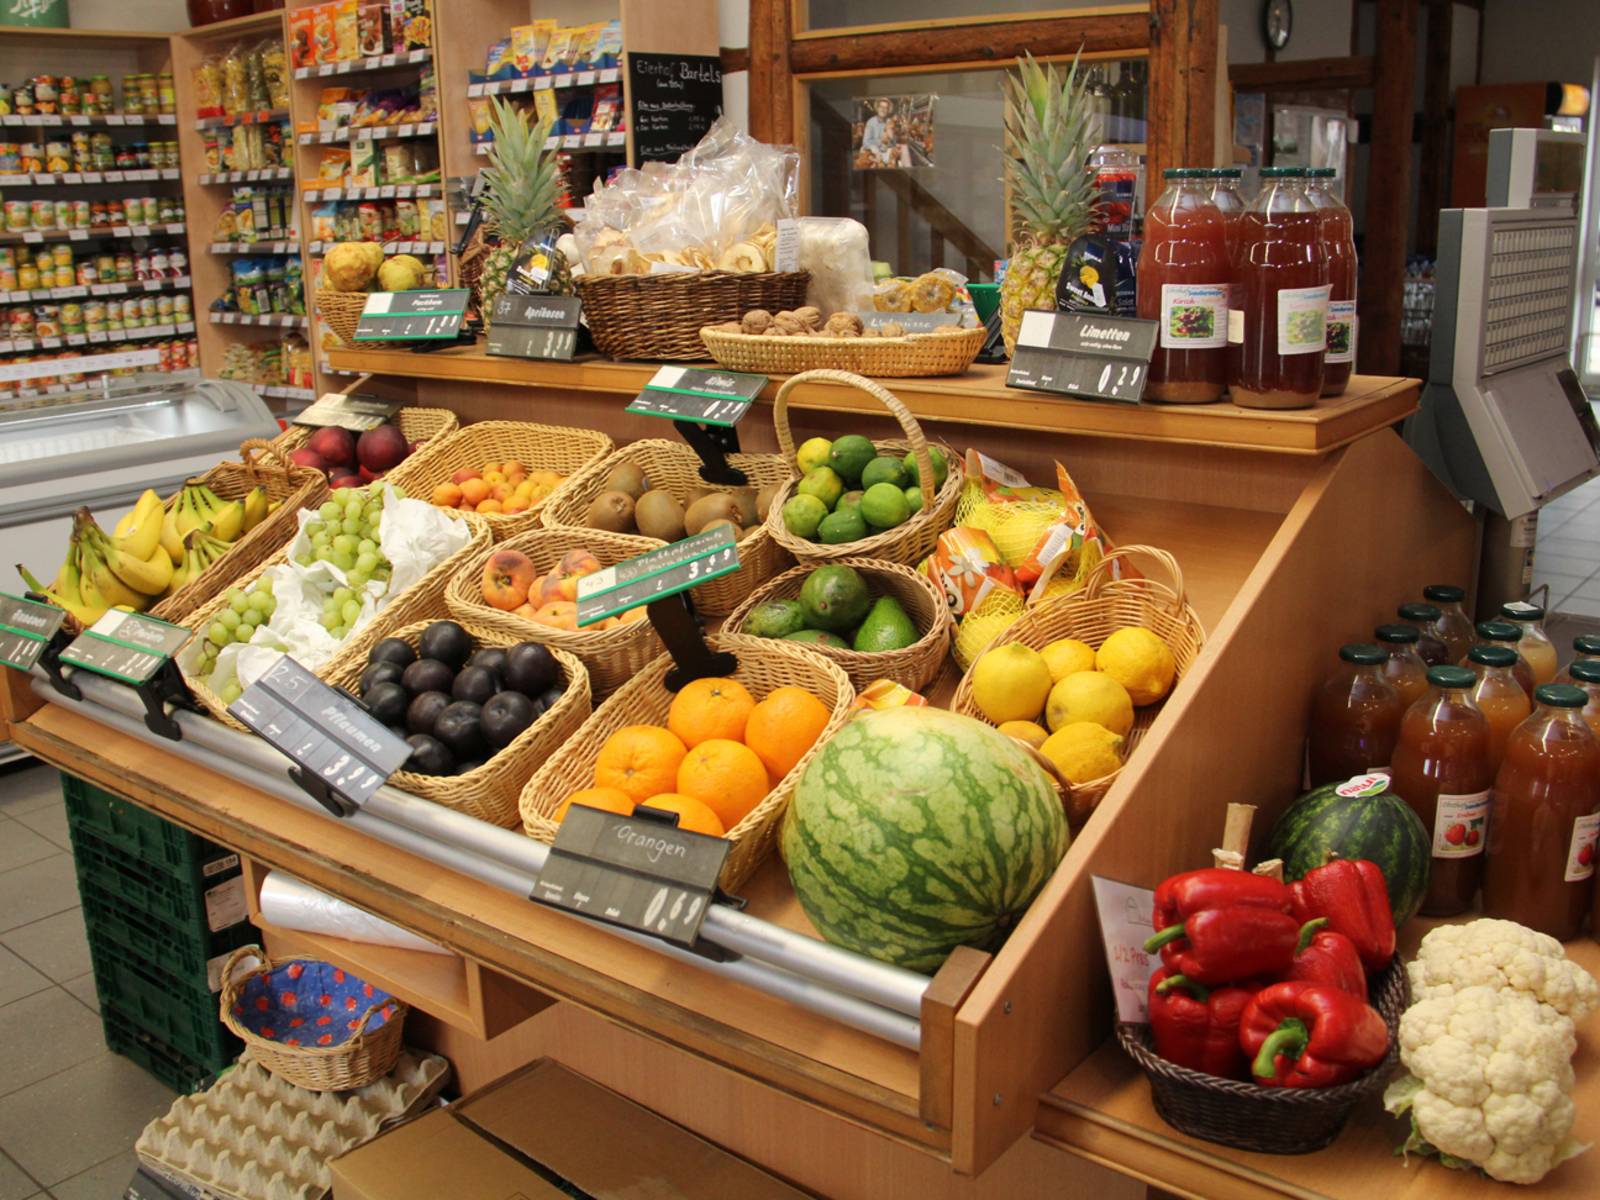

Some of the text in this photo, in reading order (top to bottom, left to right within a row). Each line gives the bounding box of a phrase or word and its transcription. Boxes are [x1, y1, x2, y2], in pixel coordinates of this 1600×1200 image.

[680, 62, 721, 83] Bartels
[524, 305, 566, 320] Aprikosen
[1079, 324, 1131, 342] Limetten
[1097, 363, 1141, 395] 0.29
[270, 664, 308, 690] 25
[320, 705, 384, 753] Pflaumen
[323, 754, 380, 789] 3.99
[616, 824, 687, 863] Orangen
[642, 887, 703, 932] 0.69
